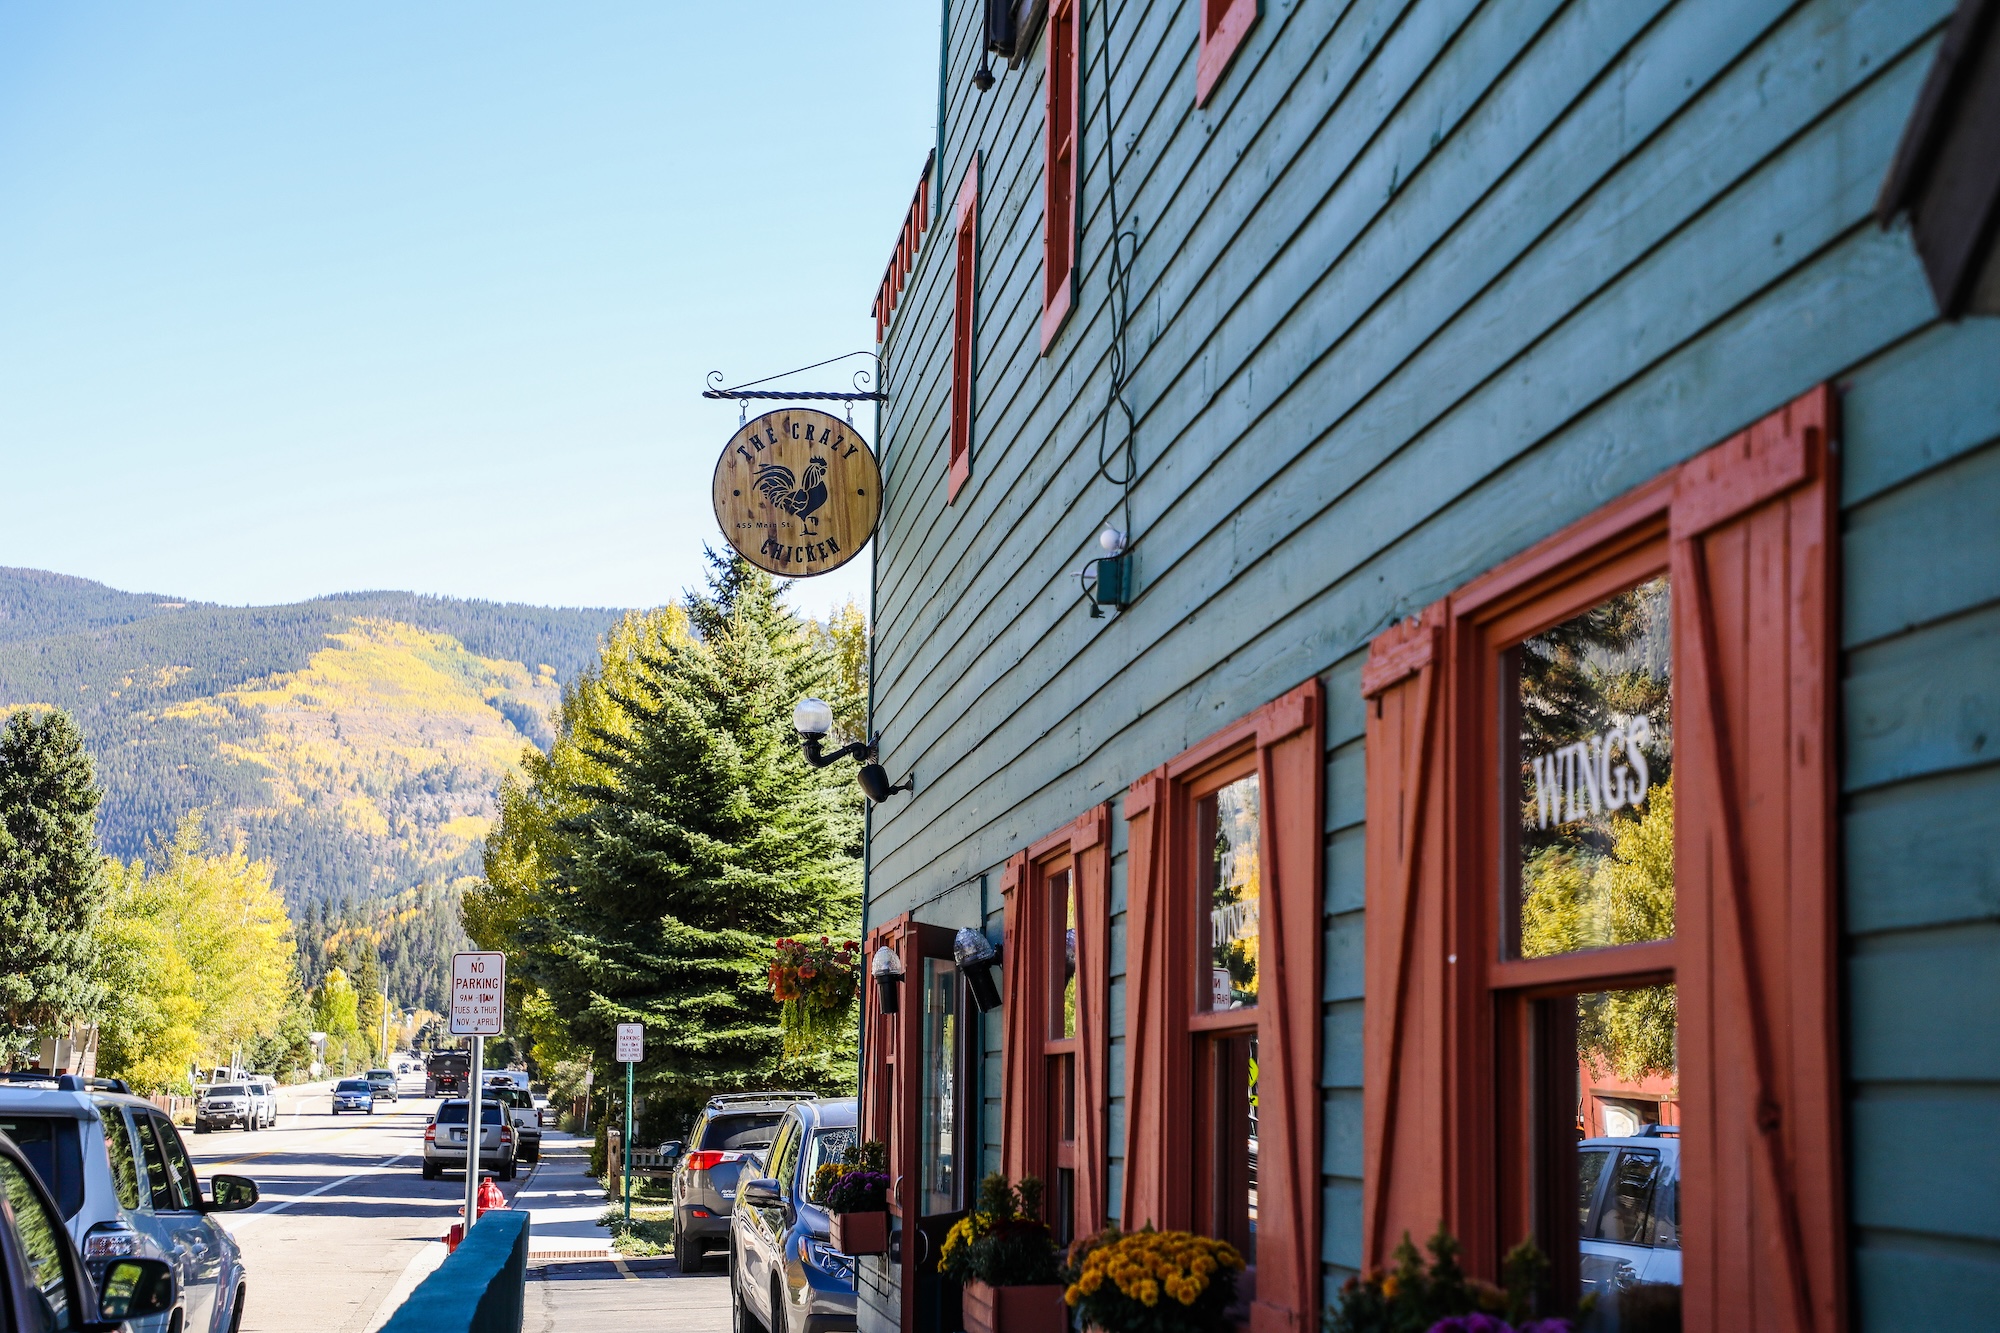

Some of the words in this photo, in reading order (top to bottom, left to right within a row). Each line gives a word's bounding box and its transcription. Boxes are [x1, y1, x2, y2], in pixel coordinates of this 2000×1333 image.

[737, 427, 778, 460] THE
[792, 422, 859, 460] CRAZY
[760, 536, 841, 563] CHICKEN
[1532, 714, 1650, 831] WINGS
[471, 962, 485, 974] NO
[455, 978, 499, 990] PARKING
[460, 994, 474, 1002] 9AM
[473, 1006, 479, 1014] &
